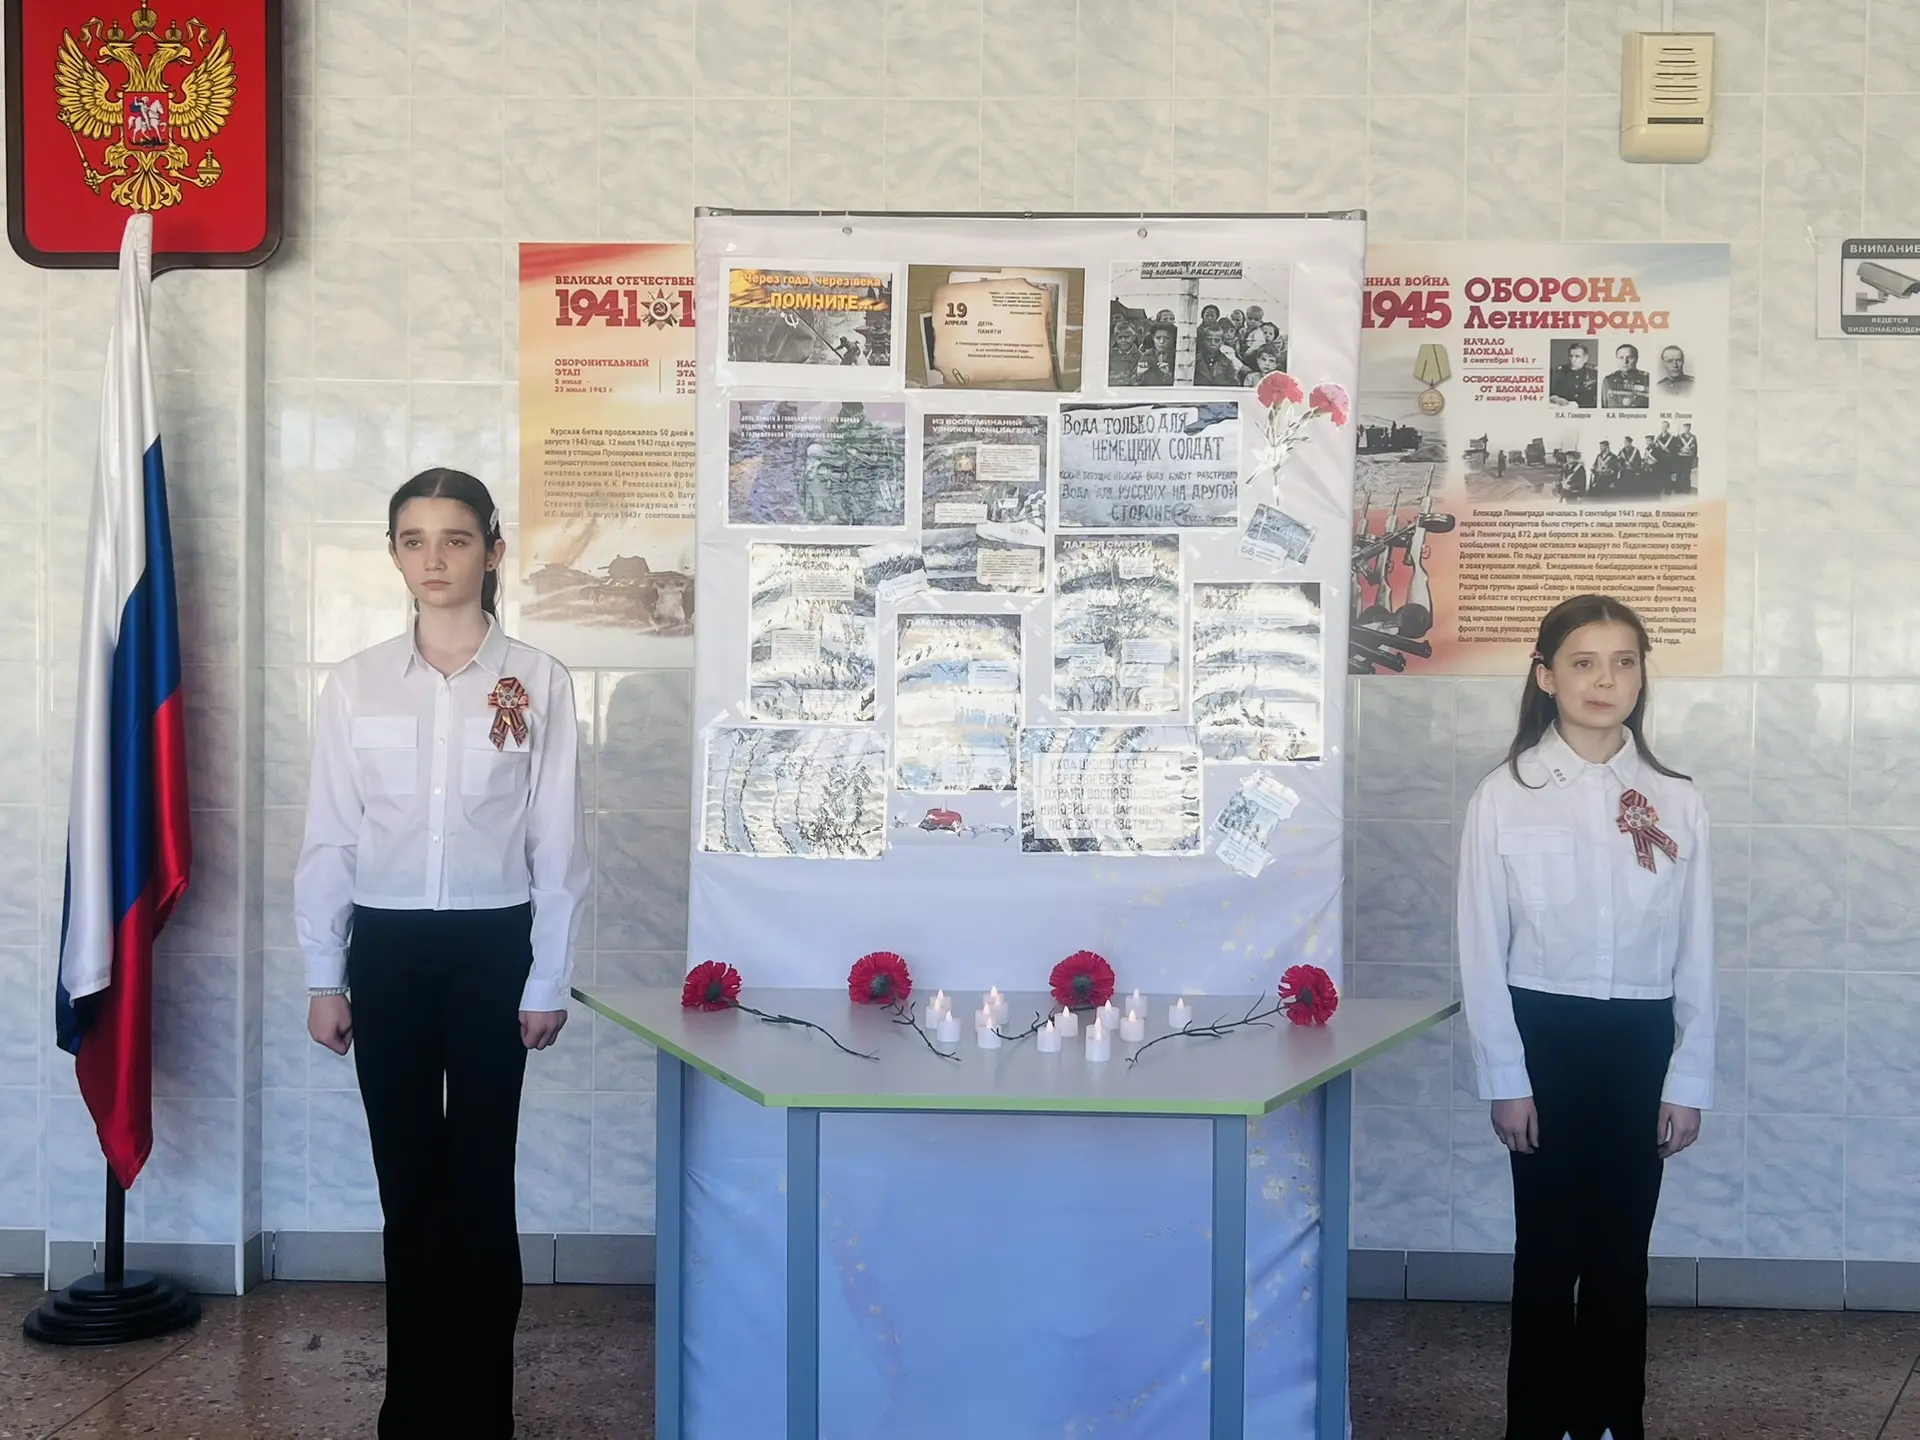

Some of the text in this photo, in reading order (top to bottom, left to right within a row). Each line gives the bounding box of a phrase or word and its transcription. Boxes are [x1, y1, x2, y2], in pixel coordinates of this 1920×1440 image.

[555, 275, 695, 286] ВЕЛИКАЯ ОТЕЧЕСТВЕН
[744, 272, 881, 287] Через года, через века
[1404, 274, 1450, 286] ВОЙНА
[1464, 276, 1641, 303] ОБОРОНА
[770, 292, 874, 310] ПОМНИТЕ...
[555, 289, 641, 327] 1941
[946, 302, 968, 318] 19
[1362, 290, 1451, 329] 1945
[1463, 305, 1670, 334] Ленинграда
[1463, 337, 1505, 346] НАЧАЛО
[1463, 347, 1514, 356] БЛОКАДЫ
[555, 358, 649, 367] ОБОРОНИТЕЛЬНЫЙ
[555, 368, 581, 376] ЭТАП
[1463, 375, 1544, 383] ОСВОБОЖДЕНИЕ
[1480, 385, 1544, 394] ОТ БЛОКАДЫ
[946, 418, 1023, 426] ВОСПОМИНАНИЙ
[1104, 413, 1155, 434] ТОЛЬКО
[1158, 412, 1188, 434] ДЛЯ
[550, 427, 688, 438] Курская битва продолжалась 50 дней
[974, 426, 1039, 434] КОНЦЛАГЕРЕЙ
[544, 438, 571, 446] августа
[572, 439, 588, 447] 1943
[608, 439, 615, 447] 12
[617, 439, 636, 447] июля
[637, 439, 653, 447] 1943
[654, 439, 670, 447] года
[602, 450, 643, 458] Прохоровка
[1092, 437, 1224, 465] НЕМЕЦКИХ СОЛДАТ
[614, 470, 672, 478] Центрального
[1118, 484, 1166, 500] РУССКИХ
[1172, 484, 1186, 500] НА
[1192, 481, 1237, 500] ДРУГОЙ
[1473, 509, 1654, 518] Блокада Ленинграда началась сентября 1941 года.
[1460, 520, 1660, 529] леровских оккупантов было стереть город.
[1477, 531, 1674, 540] Ленинград 872 дня боролся Единственным
[1063, 540, 1153, 549] ЛАГЕРЯ СМЕРТИ
[1459, 541, 1691, 550] сообщения городом оставался маршрут Ладожскому озеру
[1459, 552, 1698, 561] Дороге льду доставляли грузовиках продовольствие
[1465, 563, 1697, 572] эвакуировали людей. Ежедневные бомбардировки страшный
[1459, 573, 1697, 582] голод город продолжал жить бороться.
[1459, 583, 1488, 592] Разгром
[1477, 593, 1508, 602] области
[1458, 605, 1515, 613] командованием
[1458, 625, 1484, 633] фронта
[1658, 626, 1696, 634] Ленинград
